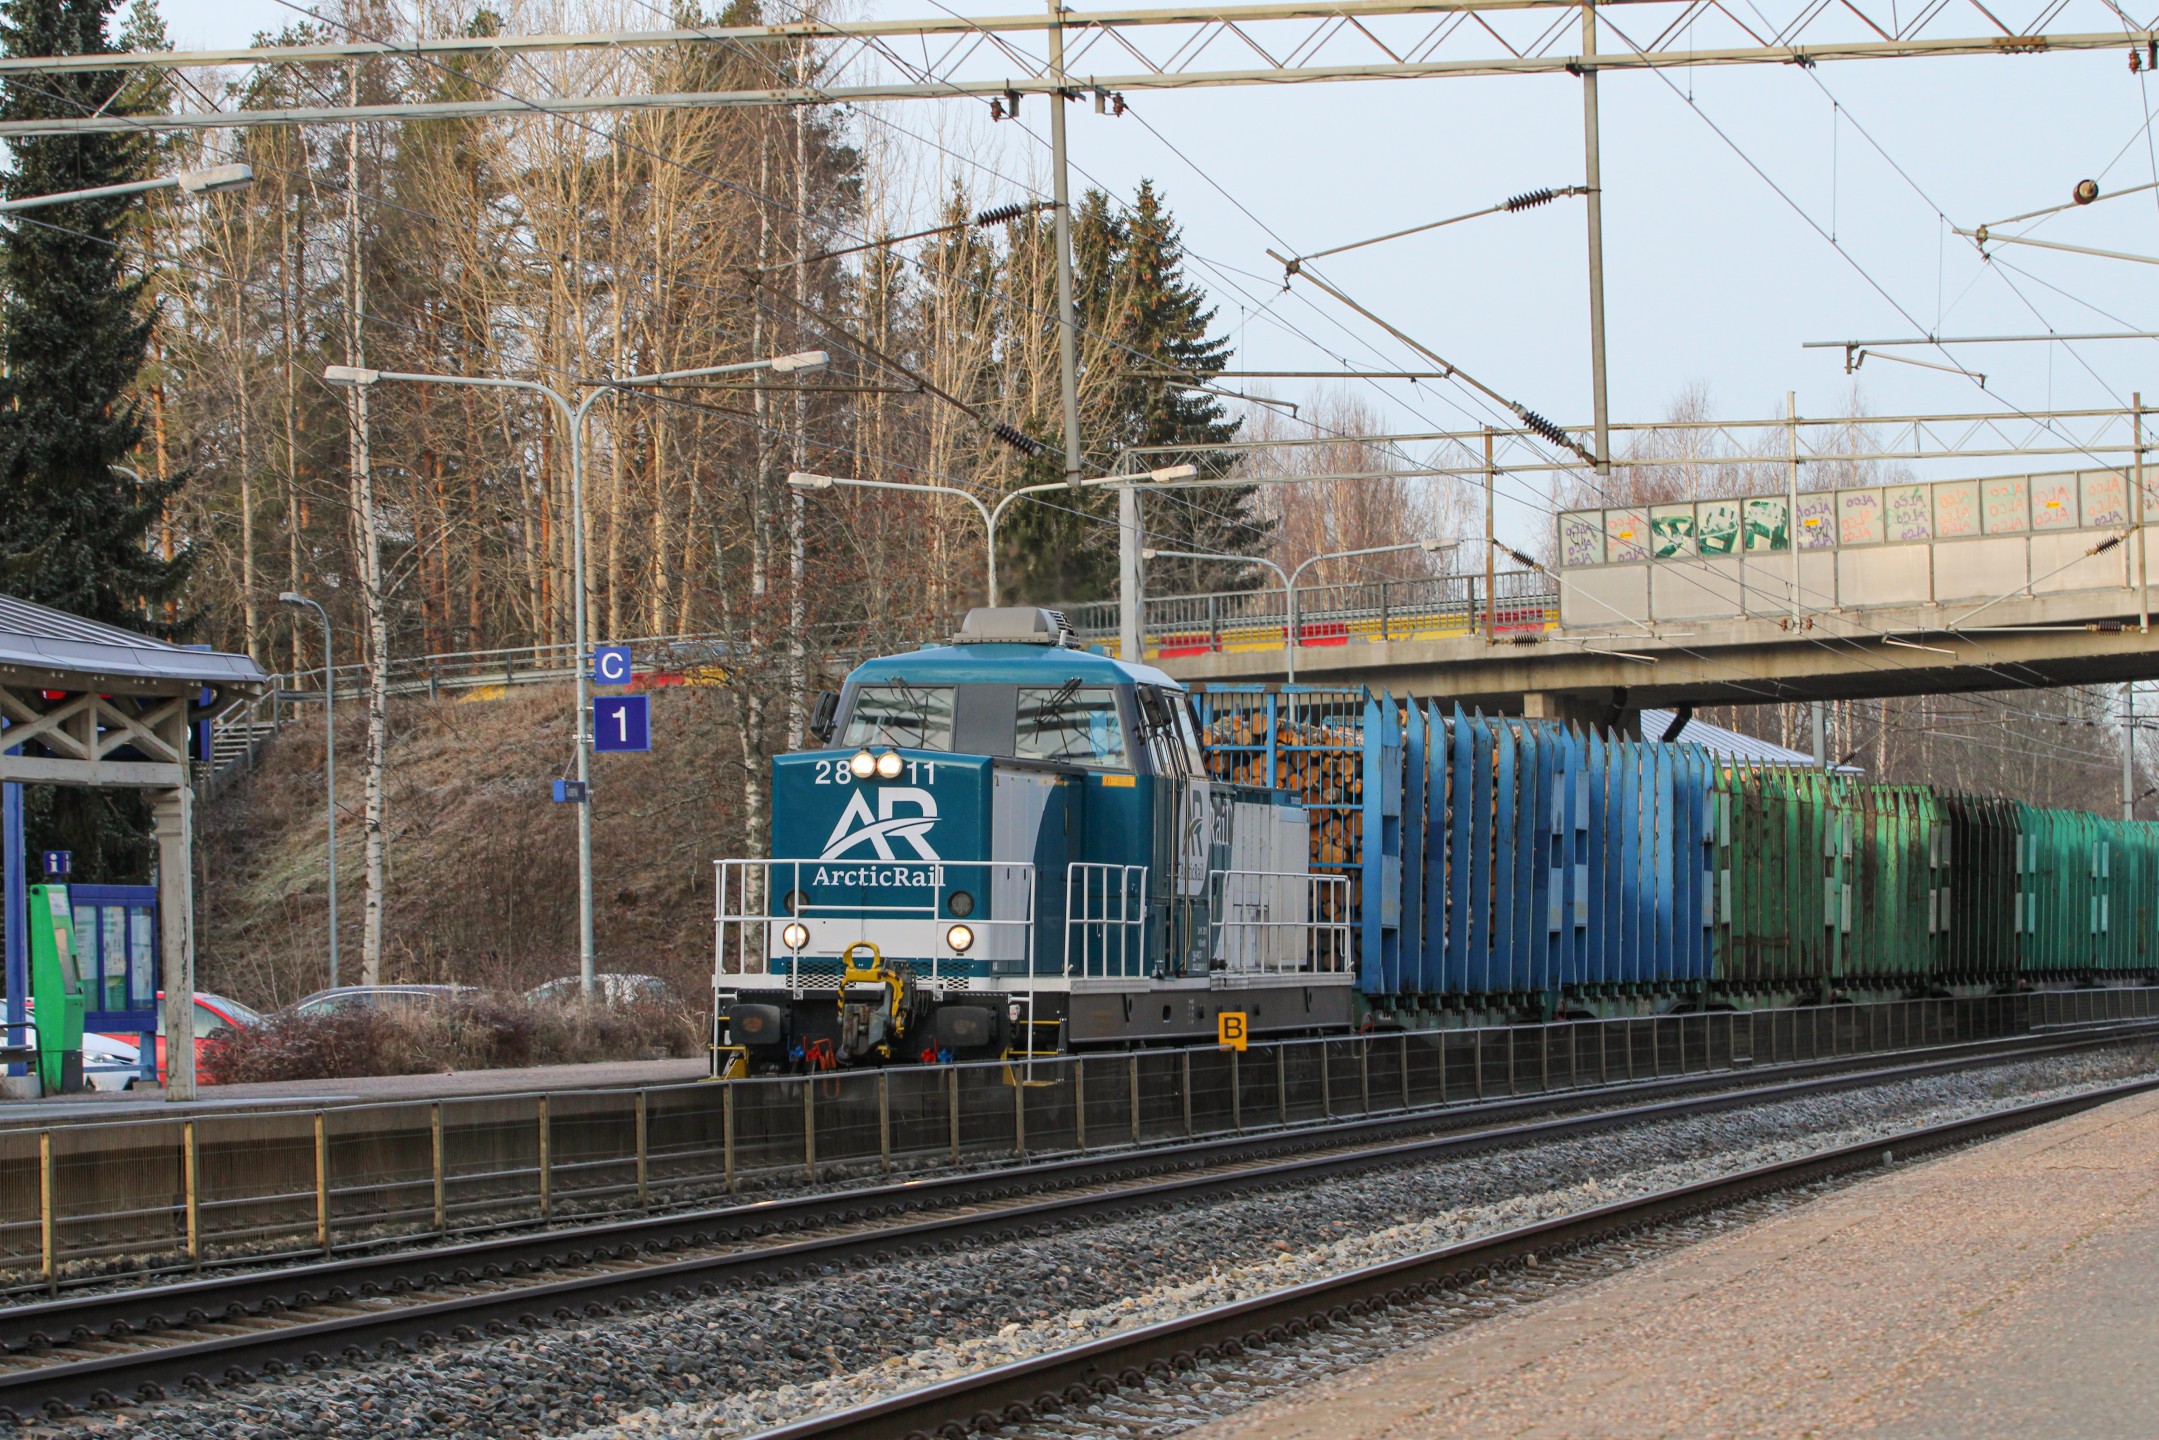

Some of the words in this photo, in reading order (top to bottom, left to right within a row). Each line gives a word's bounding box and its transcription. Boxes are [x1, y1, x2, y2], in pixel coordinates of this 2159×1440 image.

[601, 652, 624, 679] C
[611, 706, 627, 742] 1
[819, 786, 942, 861] AR
[812, 866, 946, 887] ArcticRail
[1224, 1017, 1243, 1039] B
